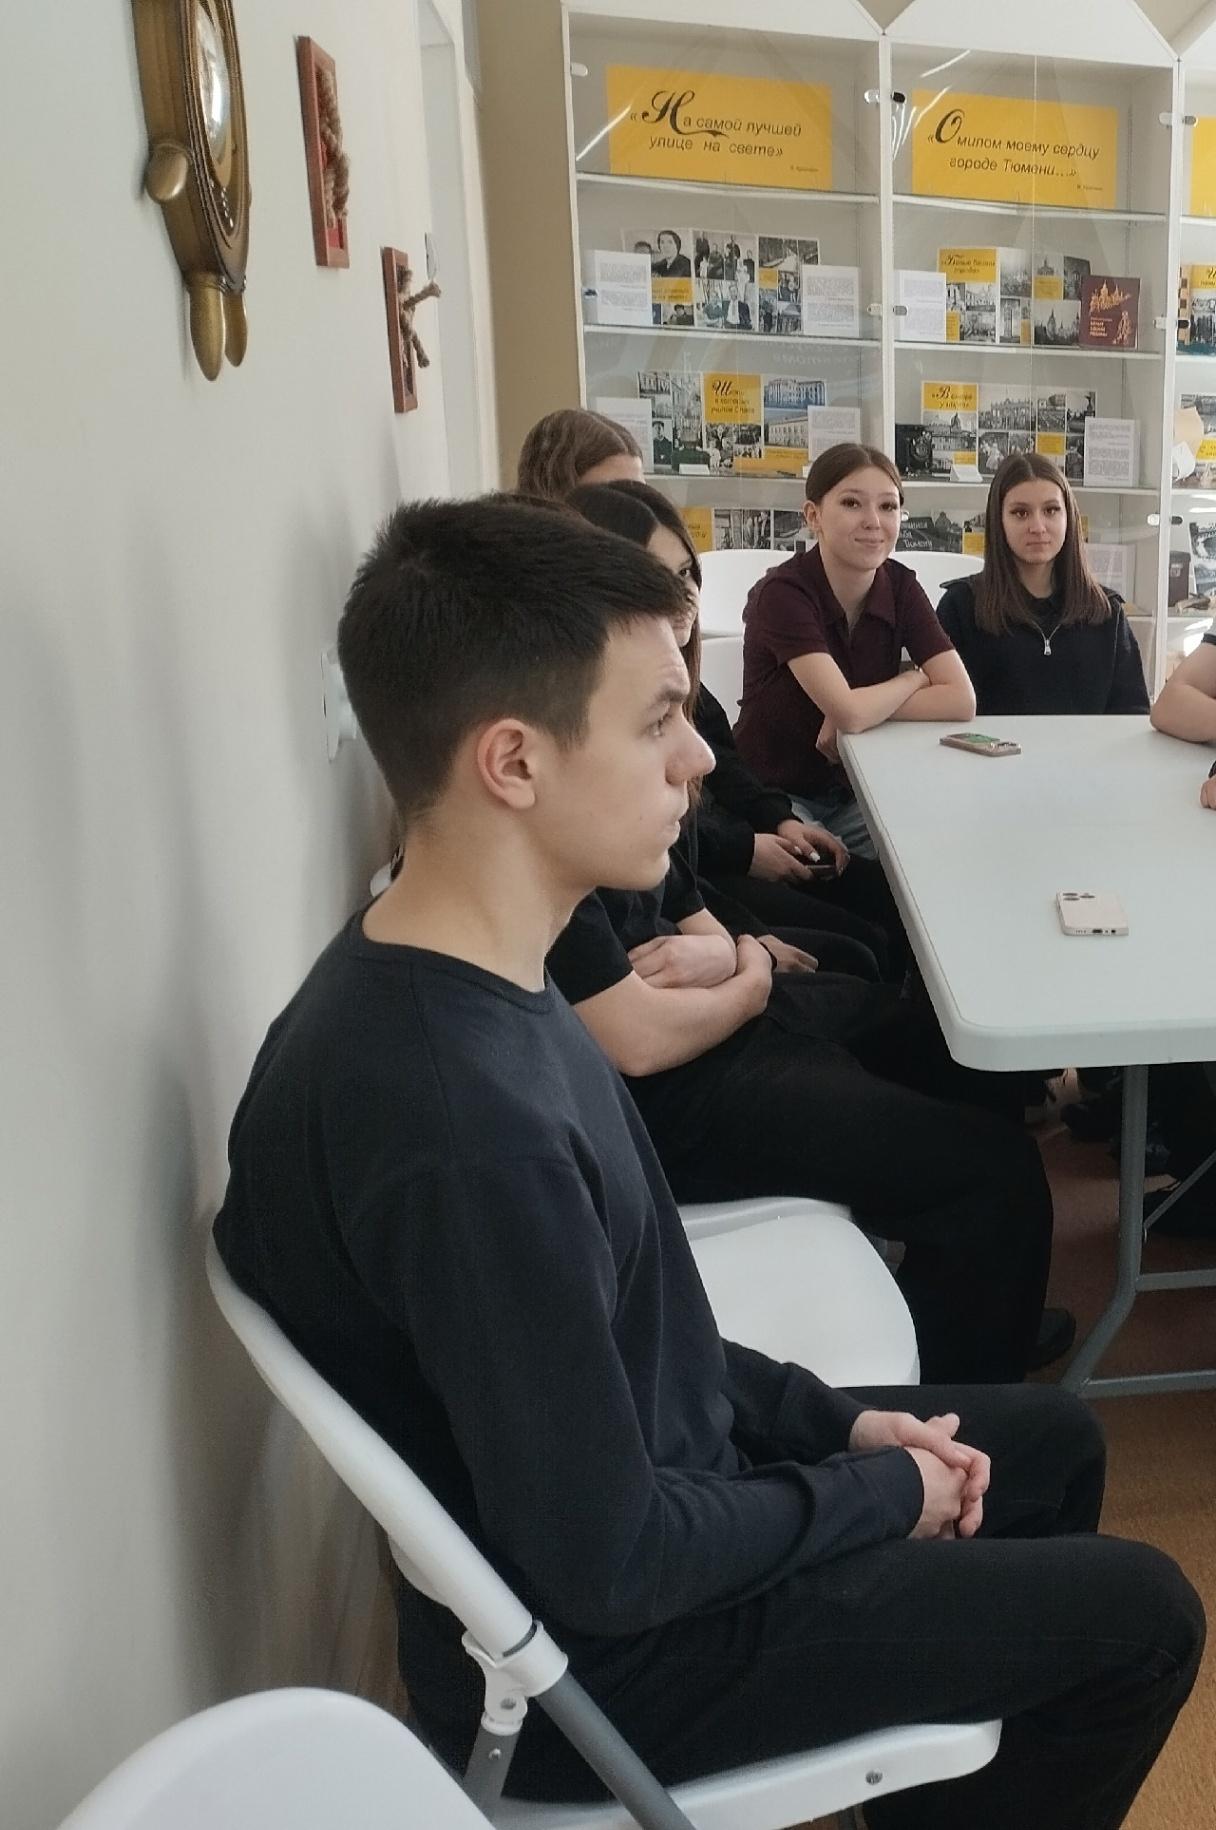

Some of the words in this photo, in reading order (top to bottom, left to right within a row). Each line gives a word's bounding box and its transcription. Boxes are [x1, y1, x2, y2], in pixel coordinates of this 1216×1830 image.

[696, 118, 742, 131] самой
[746, 121, 802, 137] лучшей
[649, 136, 693, 151] улице
[703, 140, 720, 152] на
[729, 143, 783, 157] свете»
[957, 136, 1002, 149] милом
[1006, 140, 1049, 156] моему
[1053, 143, 1100, 160] сердцу
[949, 157, 998, 172] городе
